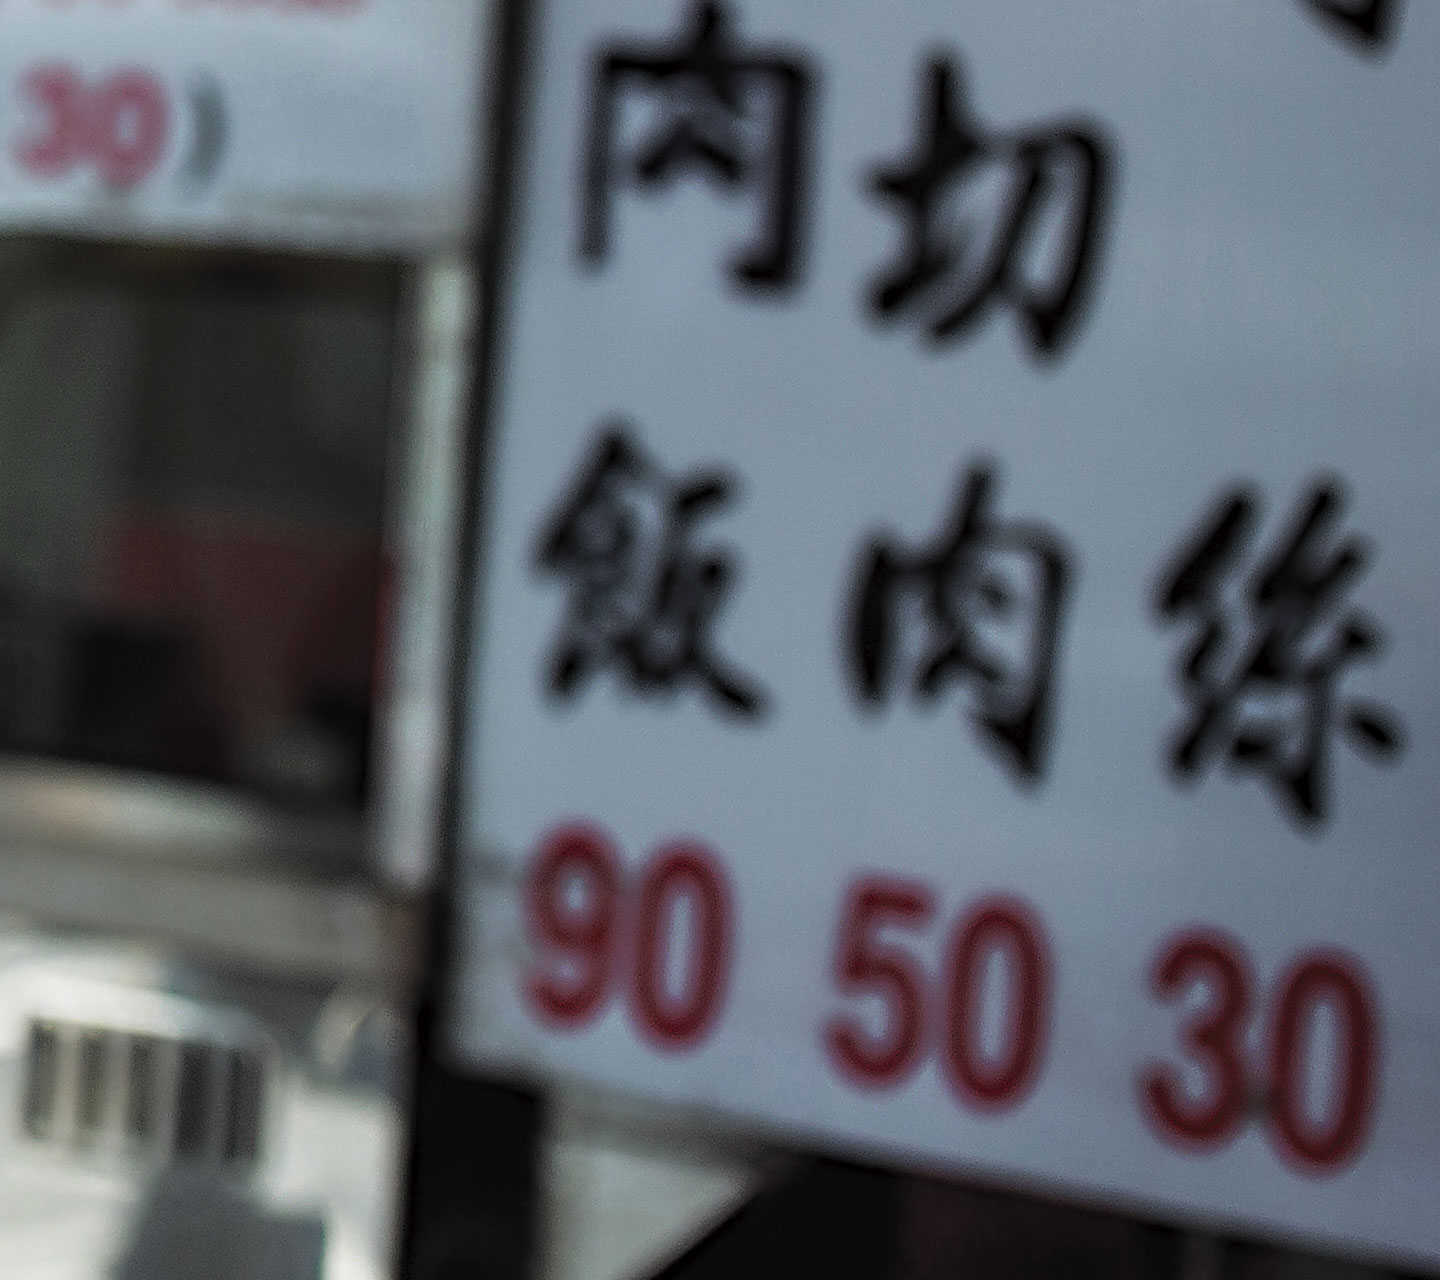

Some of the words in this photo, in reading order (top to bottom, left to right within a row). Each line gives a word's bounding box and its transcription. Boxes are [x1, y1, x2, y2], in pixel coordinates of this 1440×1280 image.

[518, 814, 740, 1058] 90
[816, 864, 1058, 1118] 50
[1134, 922, 1386, 1182] 30
